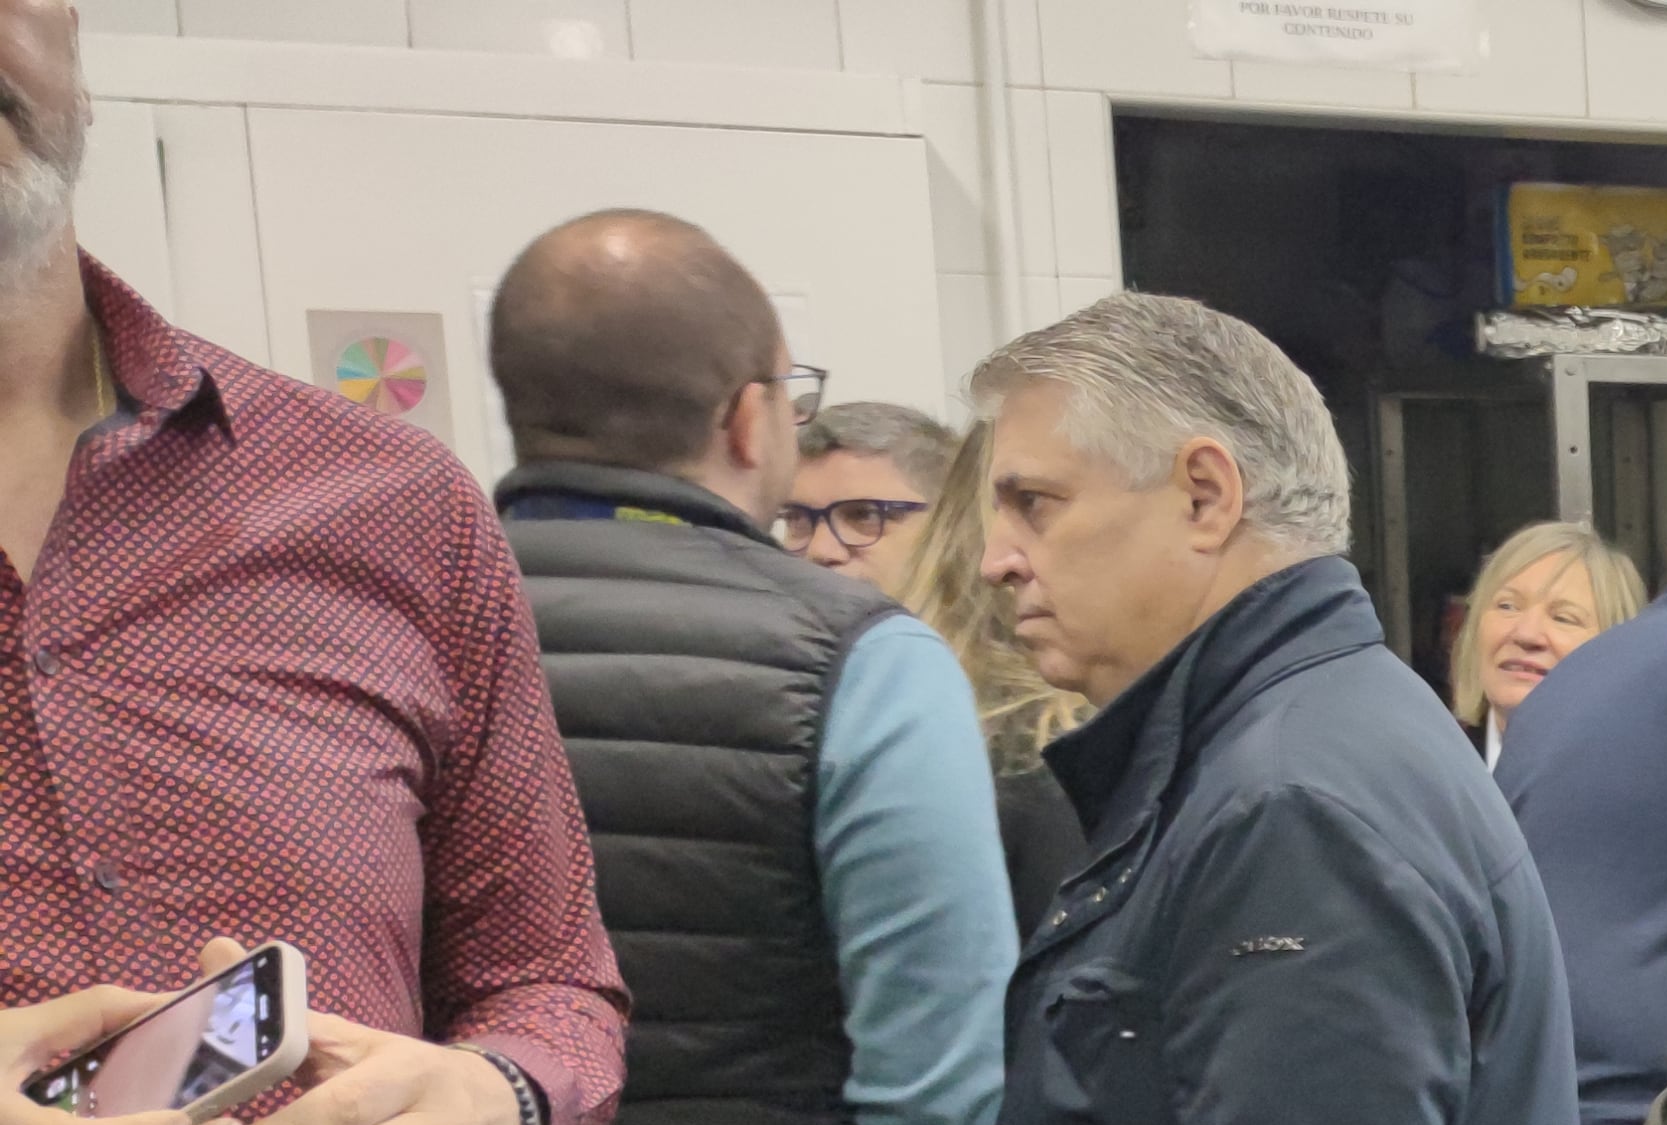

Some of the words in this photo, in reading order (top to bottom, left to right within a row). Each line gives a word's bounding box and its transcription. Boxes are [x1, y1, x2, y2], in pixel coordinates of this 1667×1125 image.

[1240, 1, 1271, 16] POR
[1271, 3, 1323, 20] FAVOR
[1327, 7, 1389, 26] RESPETE
[1395, 13, 1415, 26] SU
[1282, 22, 1374, 41] CONTENIDO
